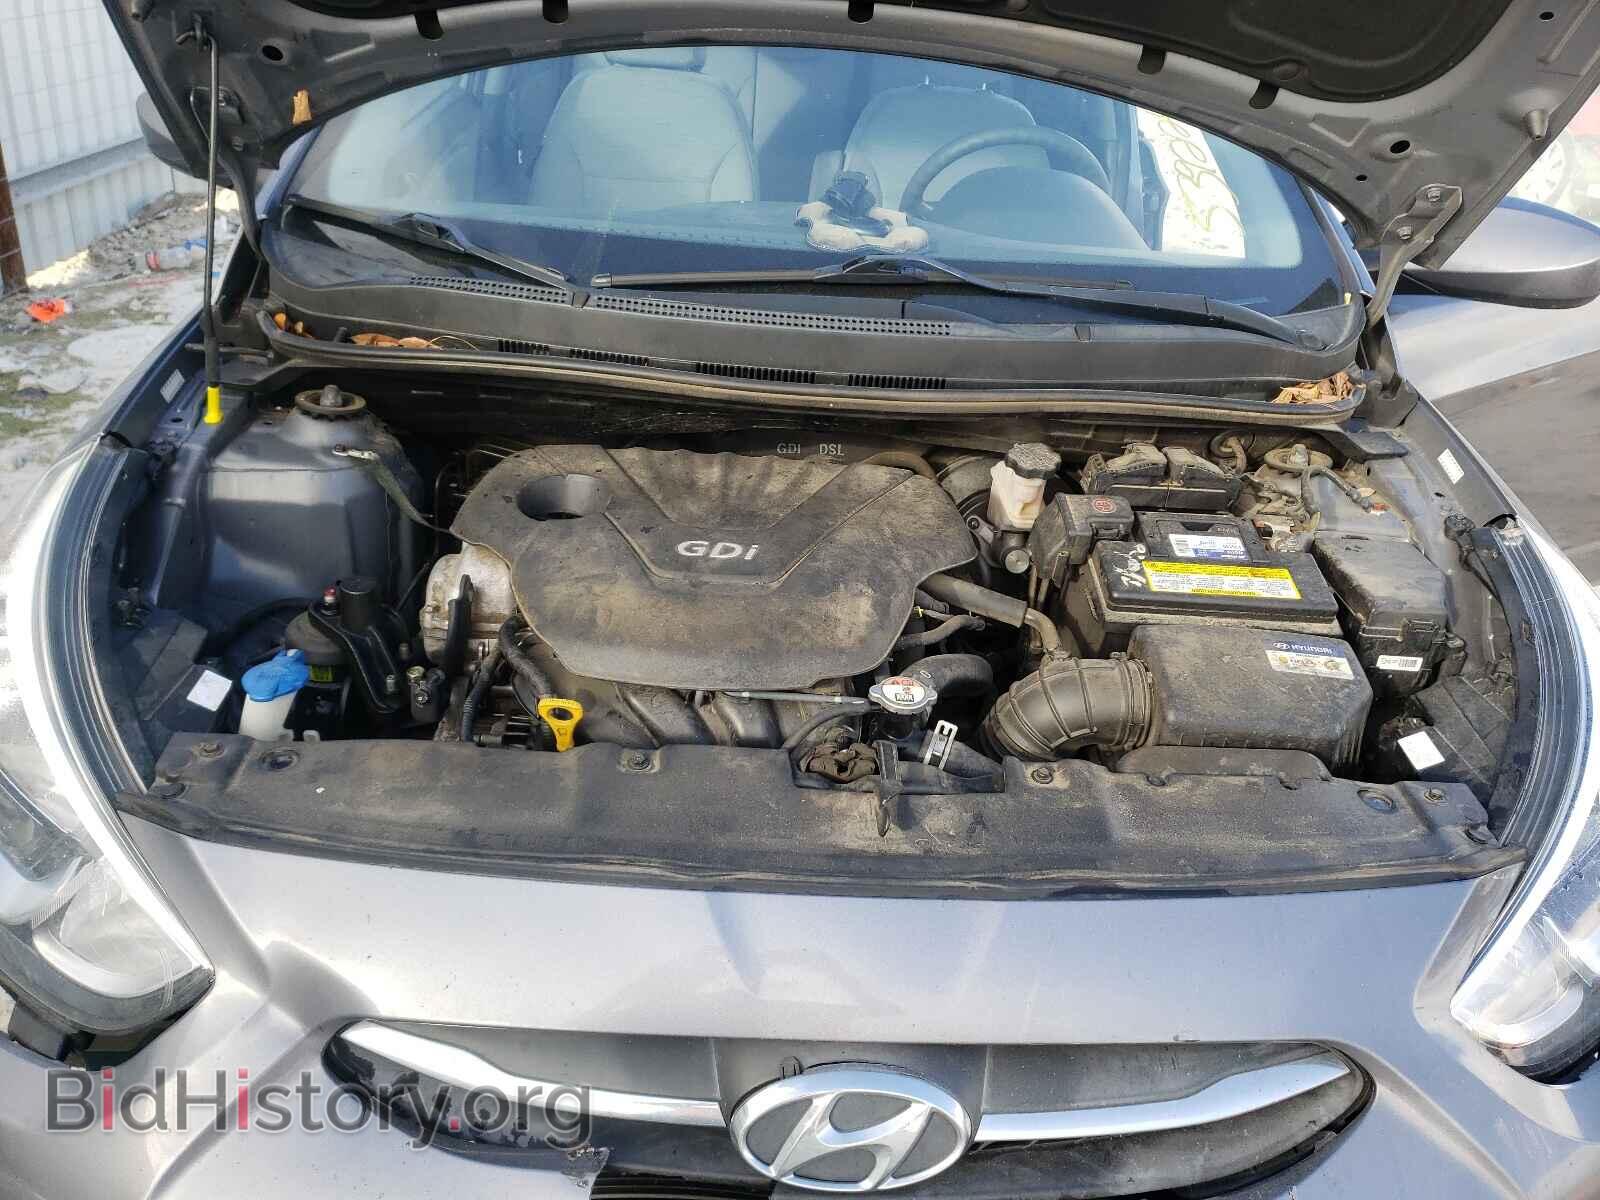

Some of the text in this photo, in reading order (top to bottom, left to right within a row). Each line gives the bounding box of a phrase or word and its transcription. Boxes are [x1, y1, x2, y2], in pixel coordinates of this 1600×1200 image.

[776, 442, 845, 456] GDI DSL
[677, 540, 759, 560] GDi
